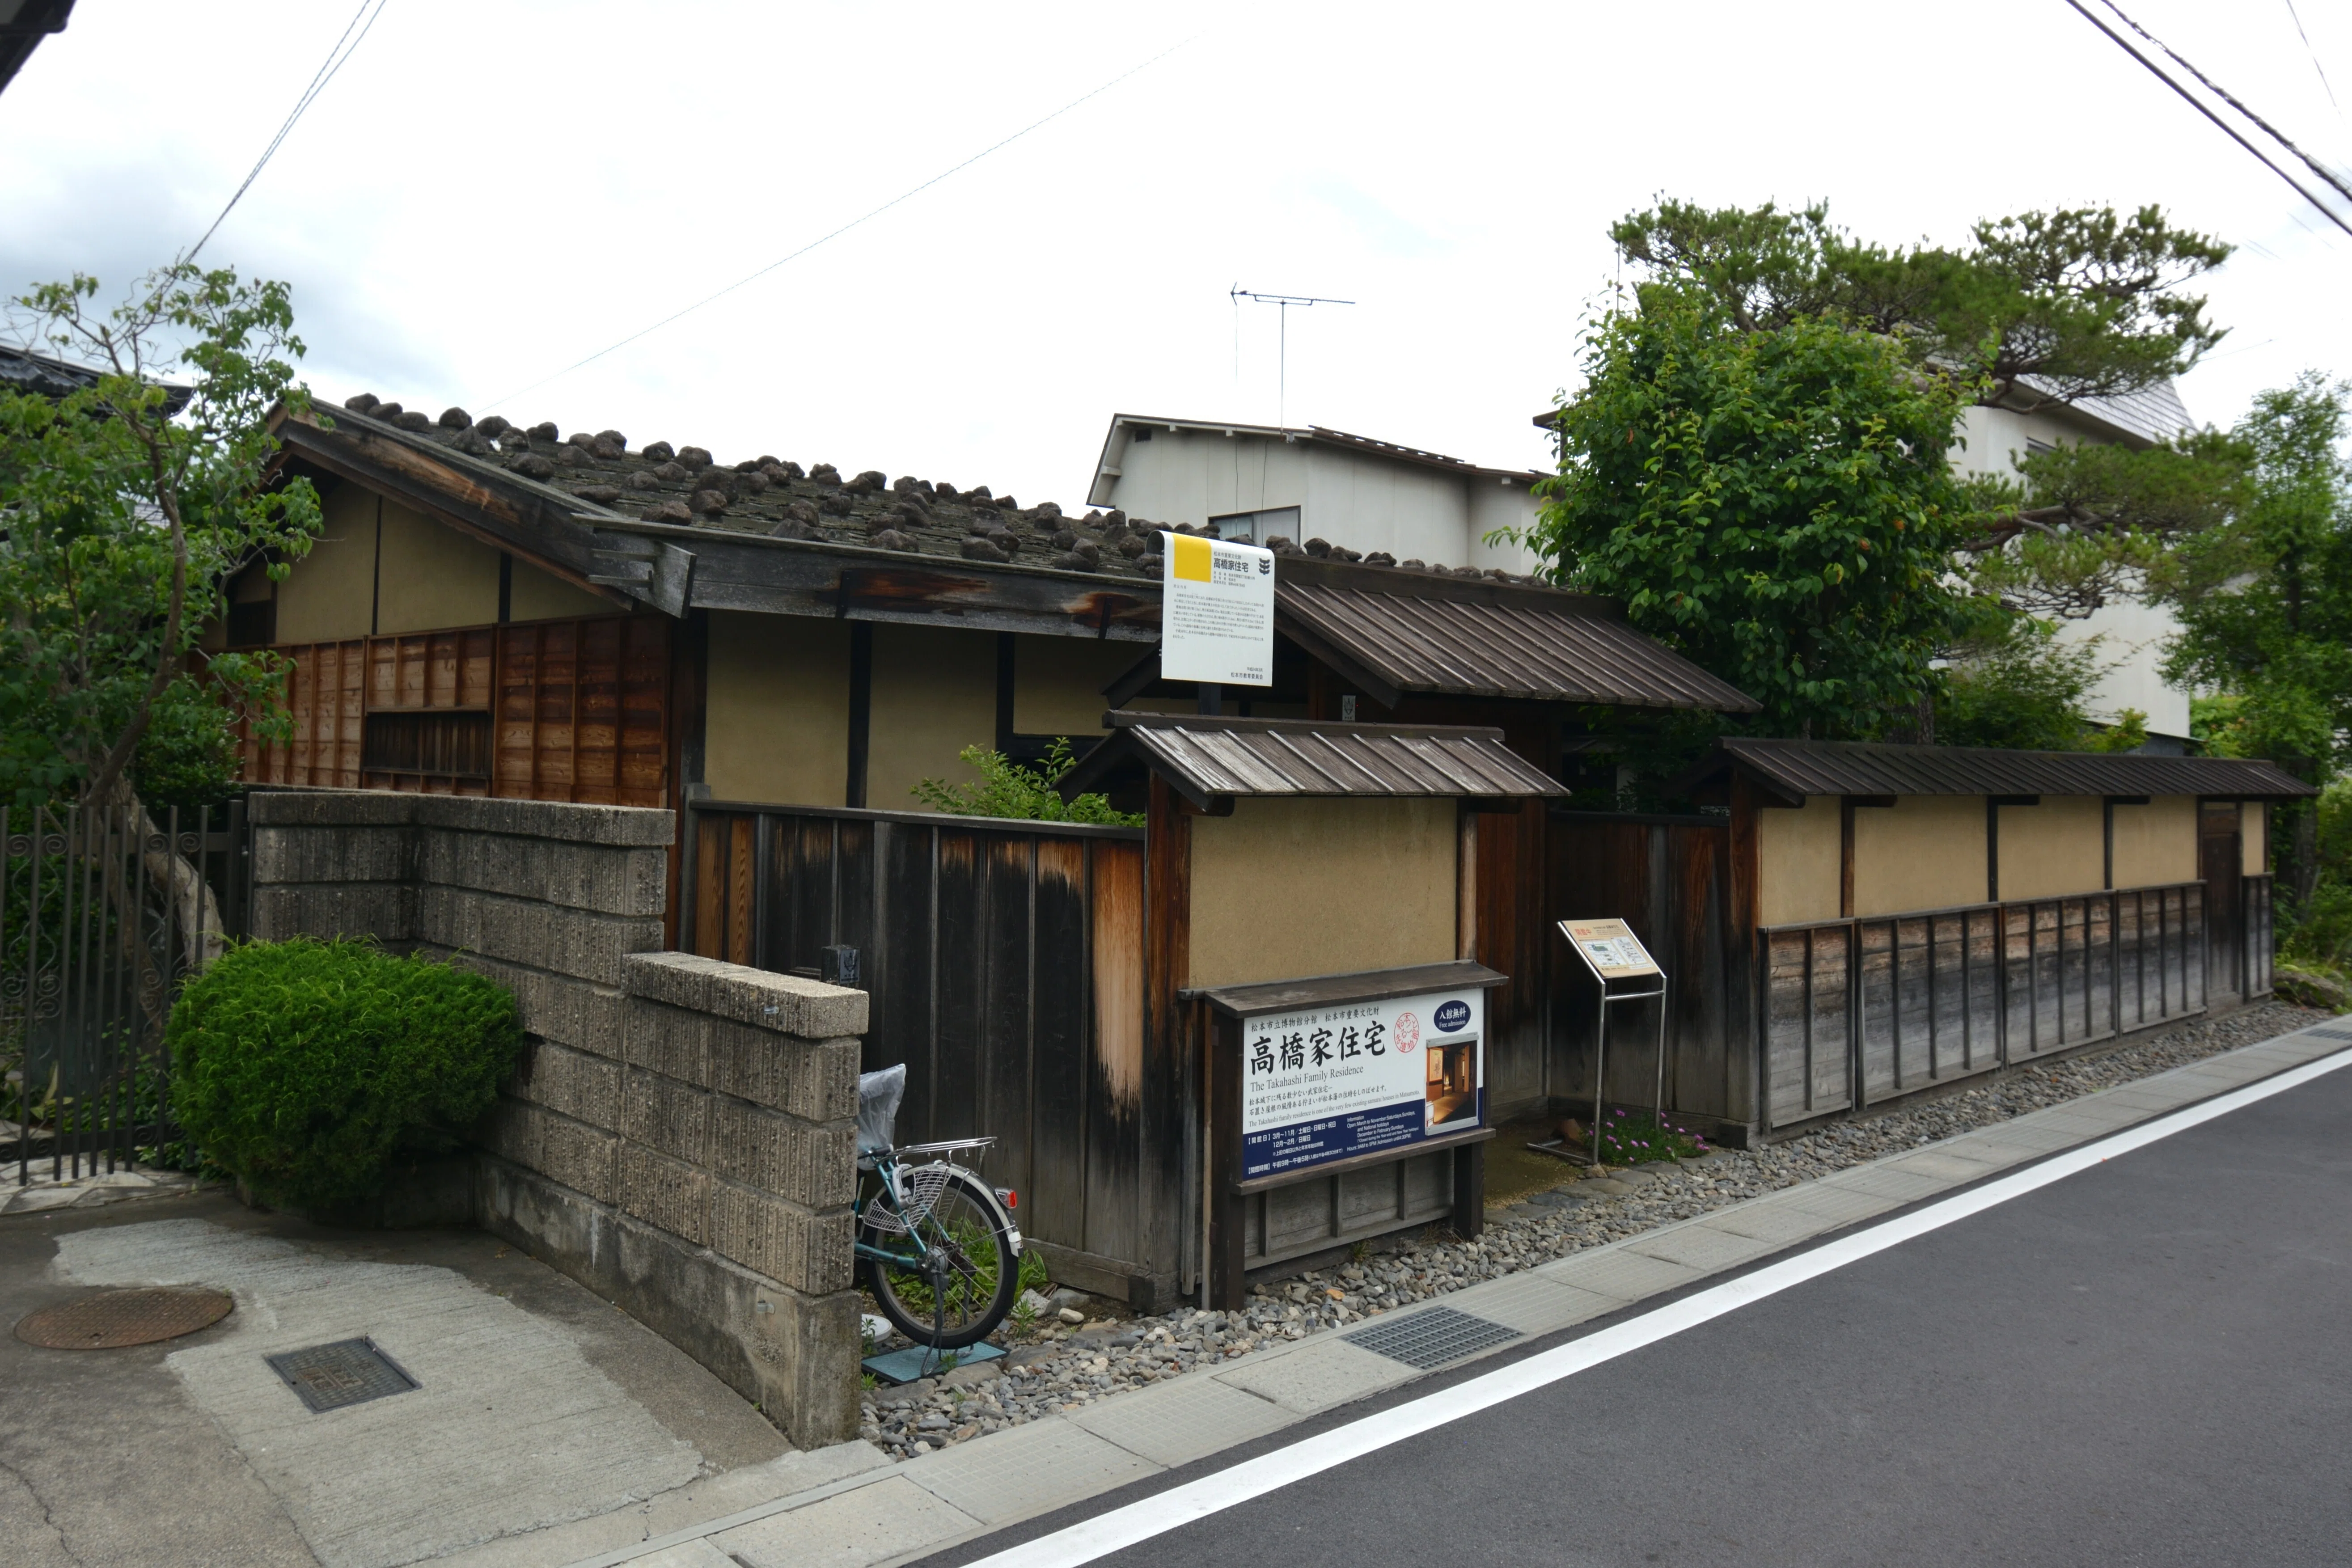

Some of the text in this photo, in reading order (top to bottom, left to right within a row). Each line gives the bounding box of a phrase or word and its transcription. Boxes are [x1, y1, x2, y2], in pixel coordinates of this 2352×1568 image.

[1214, 558, 1249, 573] 高橋家住宅
[1251, 1006, 1379, 1032] 松本市立博物館分館 松本市重要文化財
[1439, 1006, 1466, 1020] 入館無料
[1251, 1020, 1385, 1075] 高橋家住宅
[1250, 1066, 1363, 1092] The Takahashi Family Residence
[1258, 1116, 1278, 1125] Takahashi
